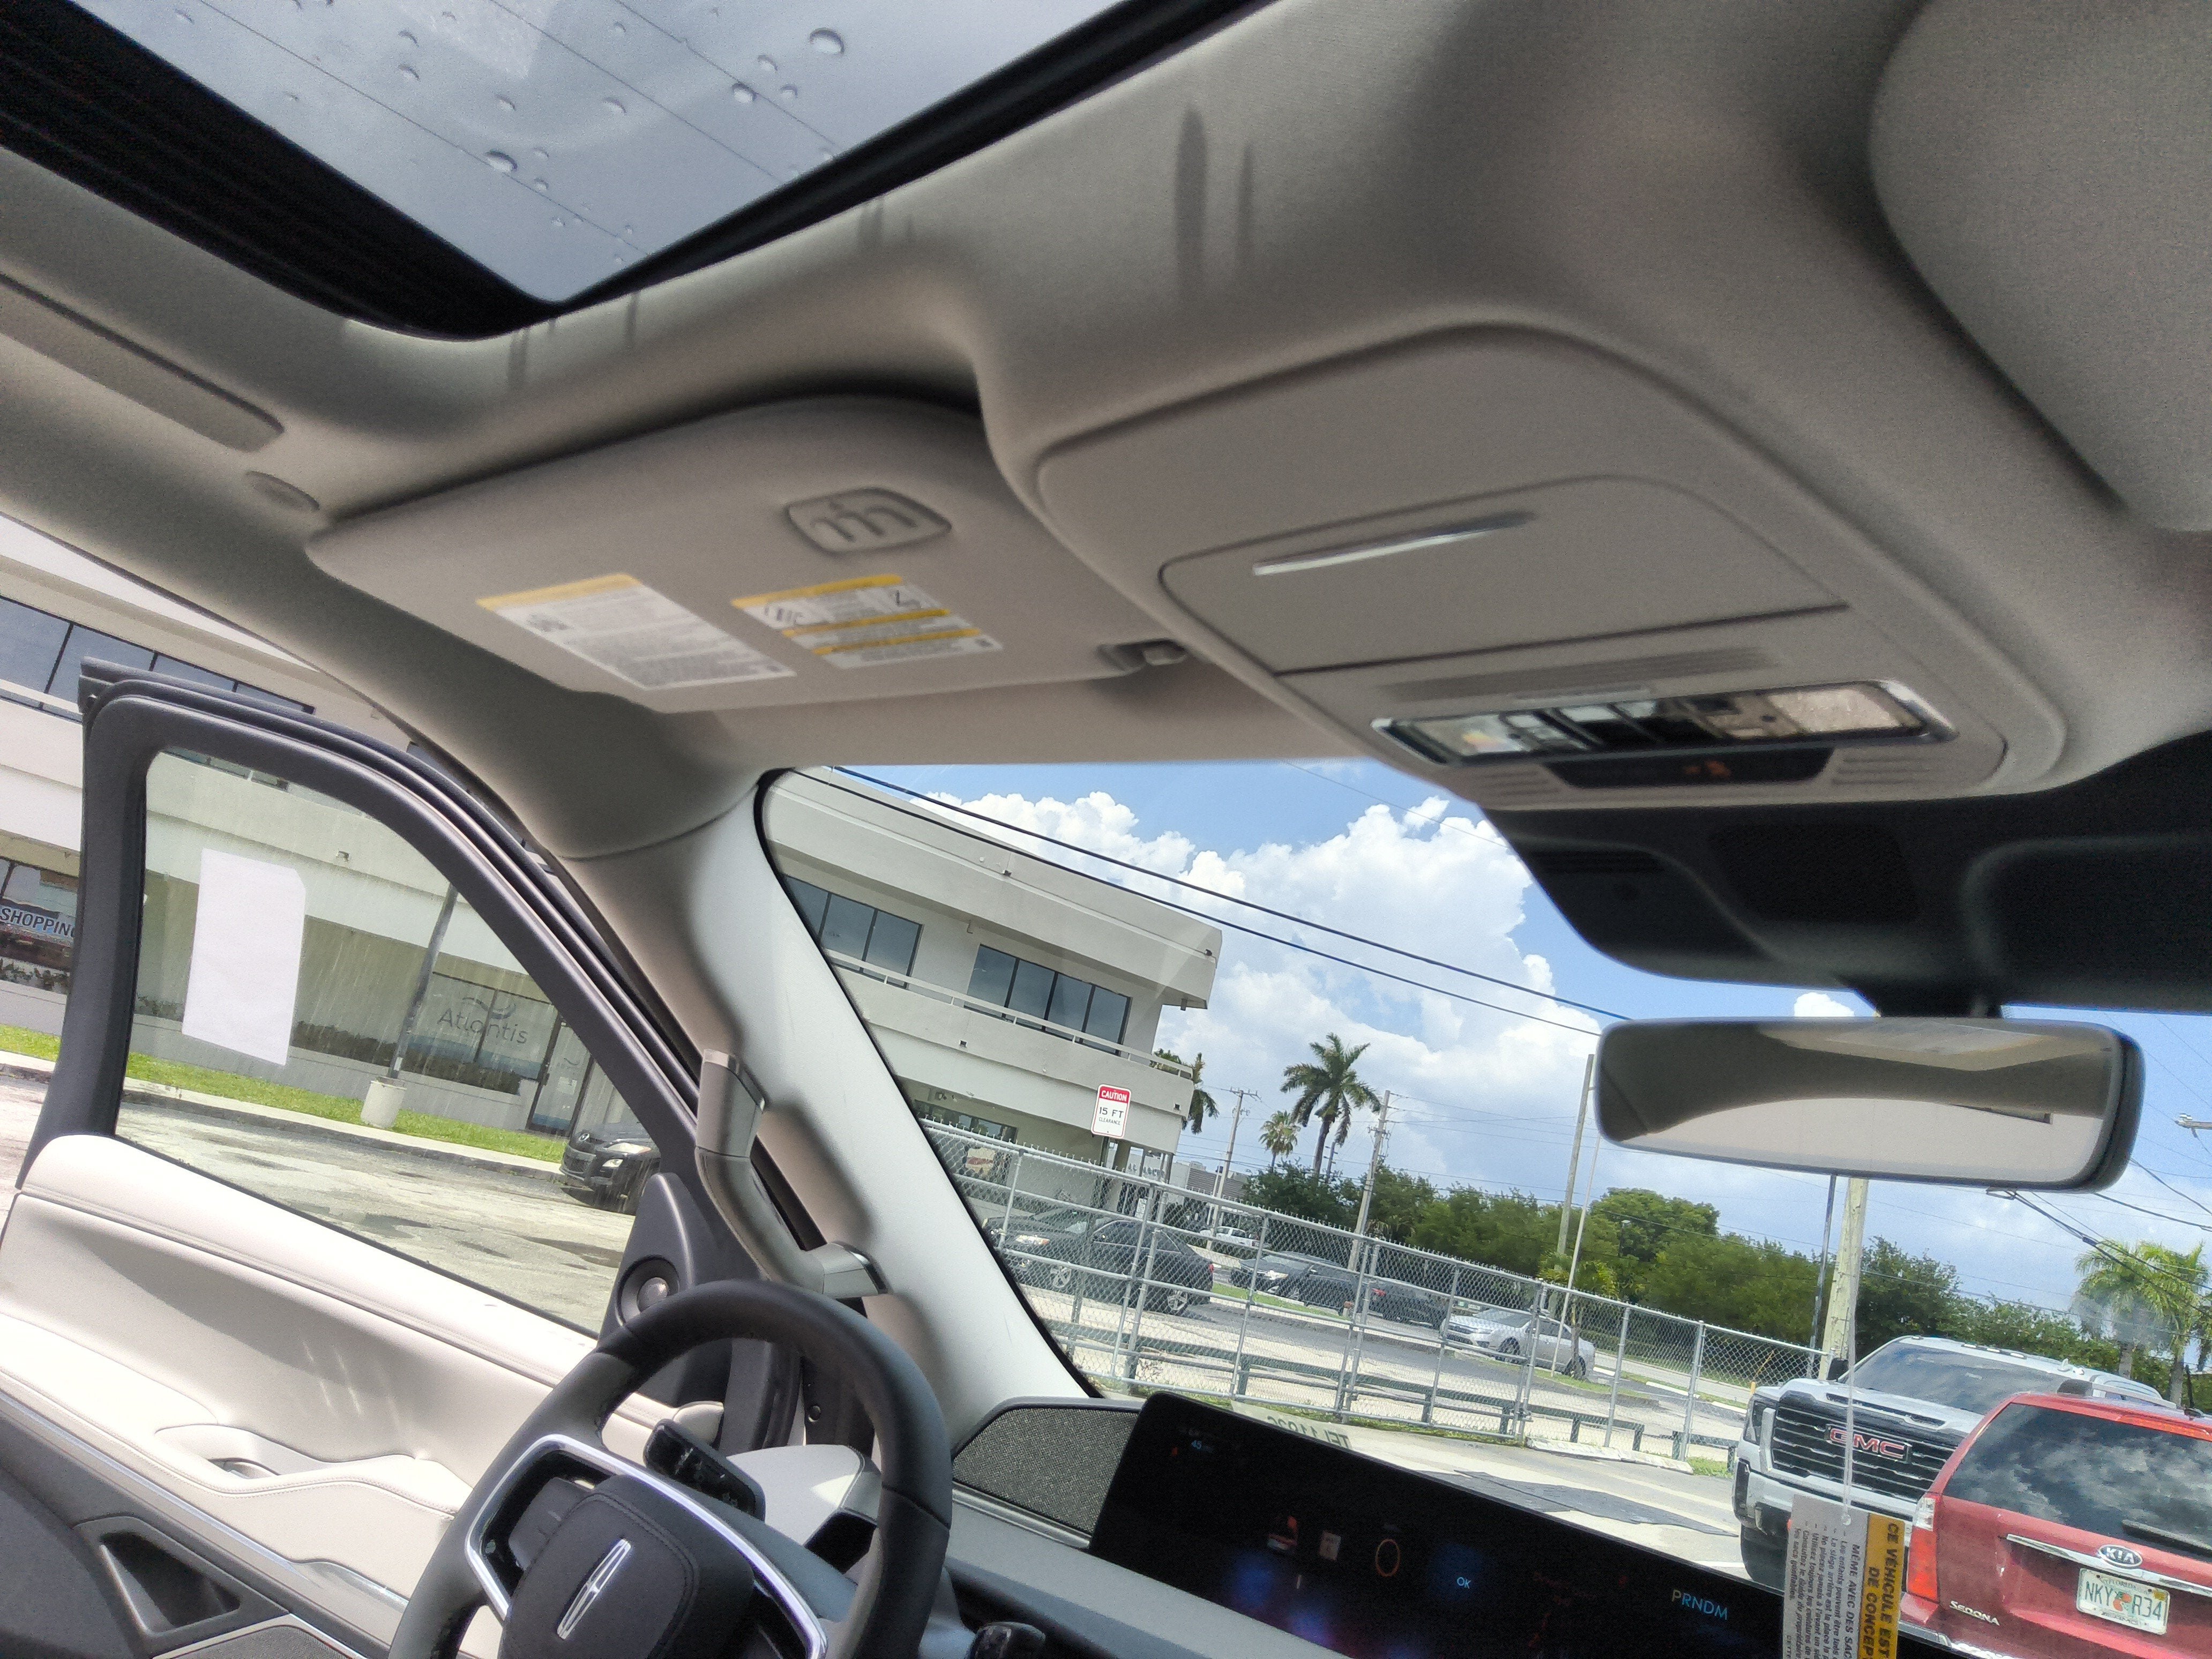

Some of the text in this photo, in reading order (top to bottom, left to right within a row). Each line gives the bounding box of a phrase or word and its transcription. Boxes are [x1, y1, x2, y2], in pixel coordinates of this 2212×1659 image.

[437, 1008, 528, 1044] Atlantis
[1101, 1090, 1127, 1102] CAUTION
[1098, 1117, 1121, 1125] CLEARANCE
[1099, 1107, 1124, 1118] 15 FT
[1830, 1428, 1904, 1459] GMC
[1888, 1523, 1899, 1543] CE
[2106, 1547, 2135, 1564] KIA
[1456, 1576, 1471, 1589] OK
[1847, 1580, 1857, 1608] AVEC
[2084, 1581, 2113, 1606] NKY
[2132, 1594, 2162, 1621] R34
[1845, 1611, 1855, 1633] DES
[1863, 1567, 1880, 1659] DE CONCEP
[1949, 1601, 2000, 1626] SEDONA
[1878, 1628, 1892, 1658] EST
